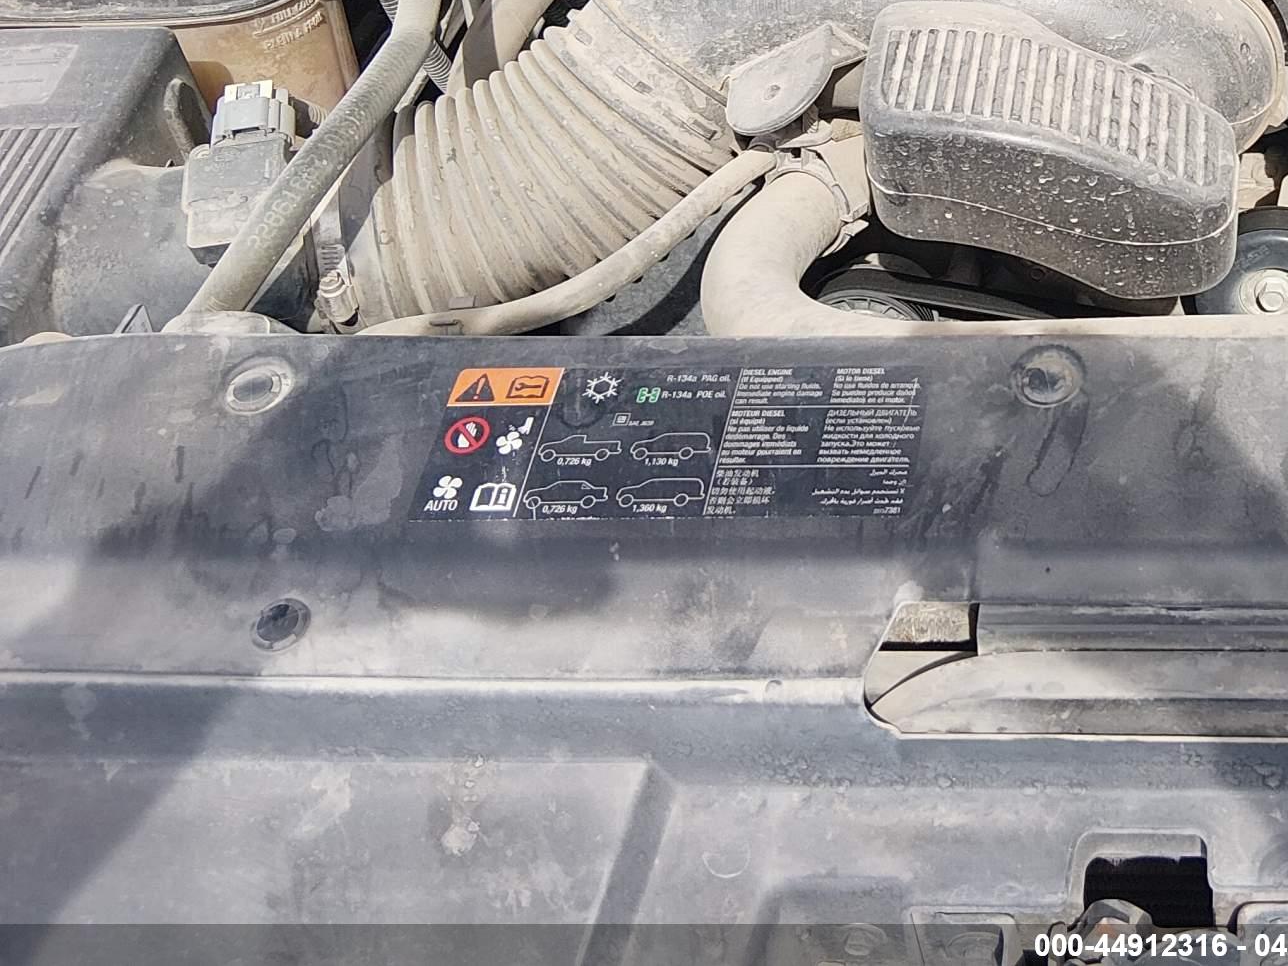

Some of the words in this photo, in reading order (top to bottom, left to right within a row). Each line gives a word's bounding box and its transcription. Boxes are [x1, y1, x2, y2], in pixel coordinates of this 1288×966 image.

[667, 375, 697, 383] R-134a
[700, 375, 718, 383] PAG
[661, 390, 692, 399] R-134a
[696, 390, 713, 399] POE
[581, 458, 592, 466] kg
[668, 458, 679, 466] kg
[424, 500, 458, 511] AUTO
[542, 505, 565, 513] 0,726
[567, 505, 578, 514] kg
[632, 504, 655, 512] 1,360
[656, 504, 667, 513] kg
